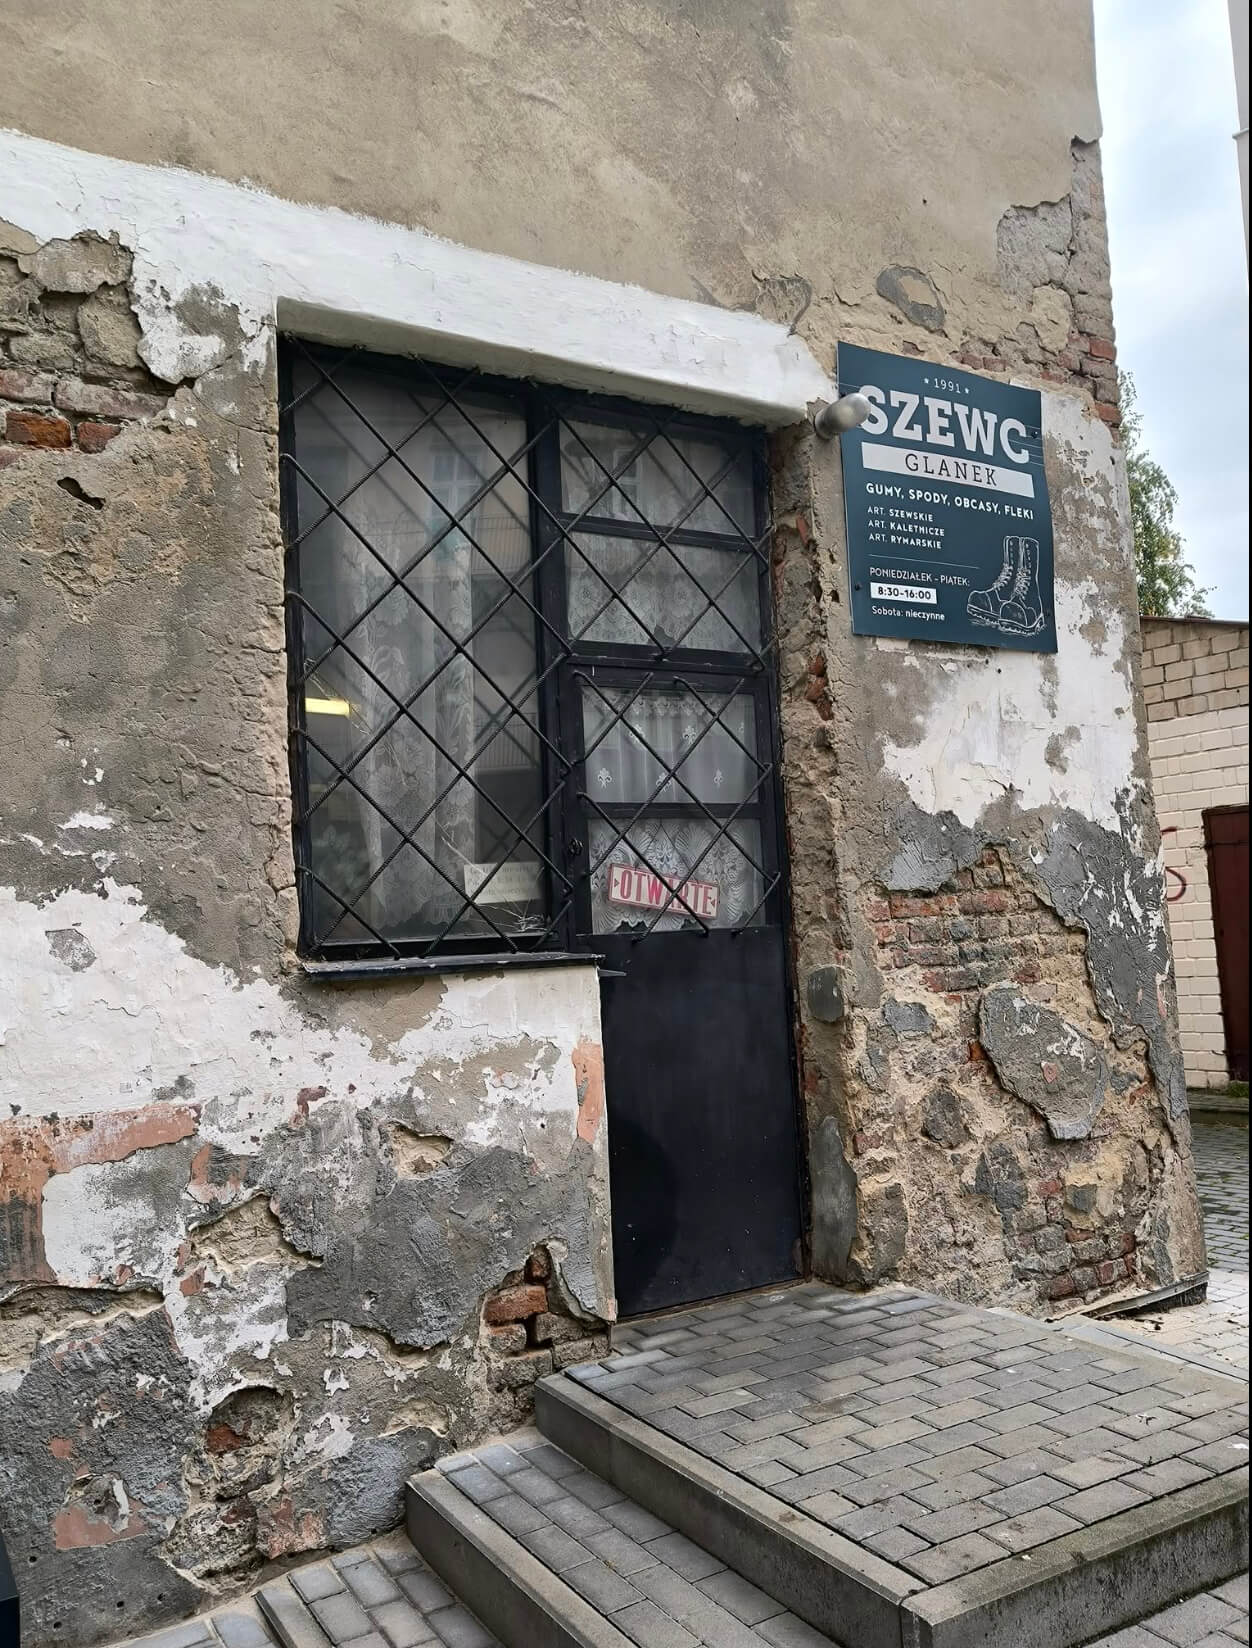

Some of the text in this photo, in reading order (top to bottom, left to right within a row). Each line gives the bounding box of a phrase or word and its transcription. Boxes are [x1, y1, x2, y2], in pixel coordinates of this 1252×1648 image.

[934, 378, 961, 394] 1991
[858, 384, 1030, 464] SZEWC
[905, 453, 997, 486] GLANEK
[866, 482, 1034, 520] GUMY, SPODY, OBCASY, FLEKI
[889, 508, 934, 522] SZEWSKIE
[890, 522, 945, 537] KALETNICZE
[890, 535, 942, 549] RYMARSKIE
[869, 567, 933, 582] PONIEDZIAŁEK
[877, 586, 931, 600] 8:30-16:00
[872, 605, 945, 622] Sobota: nieczynne
